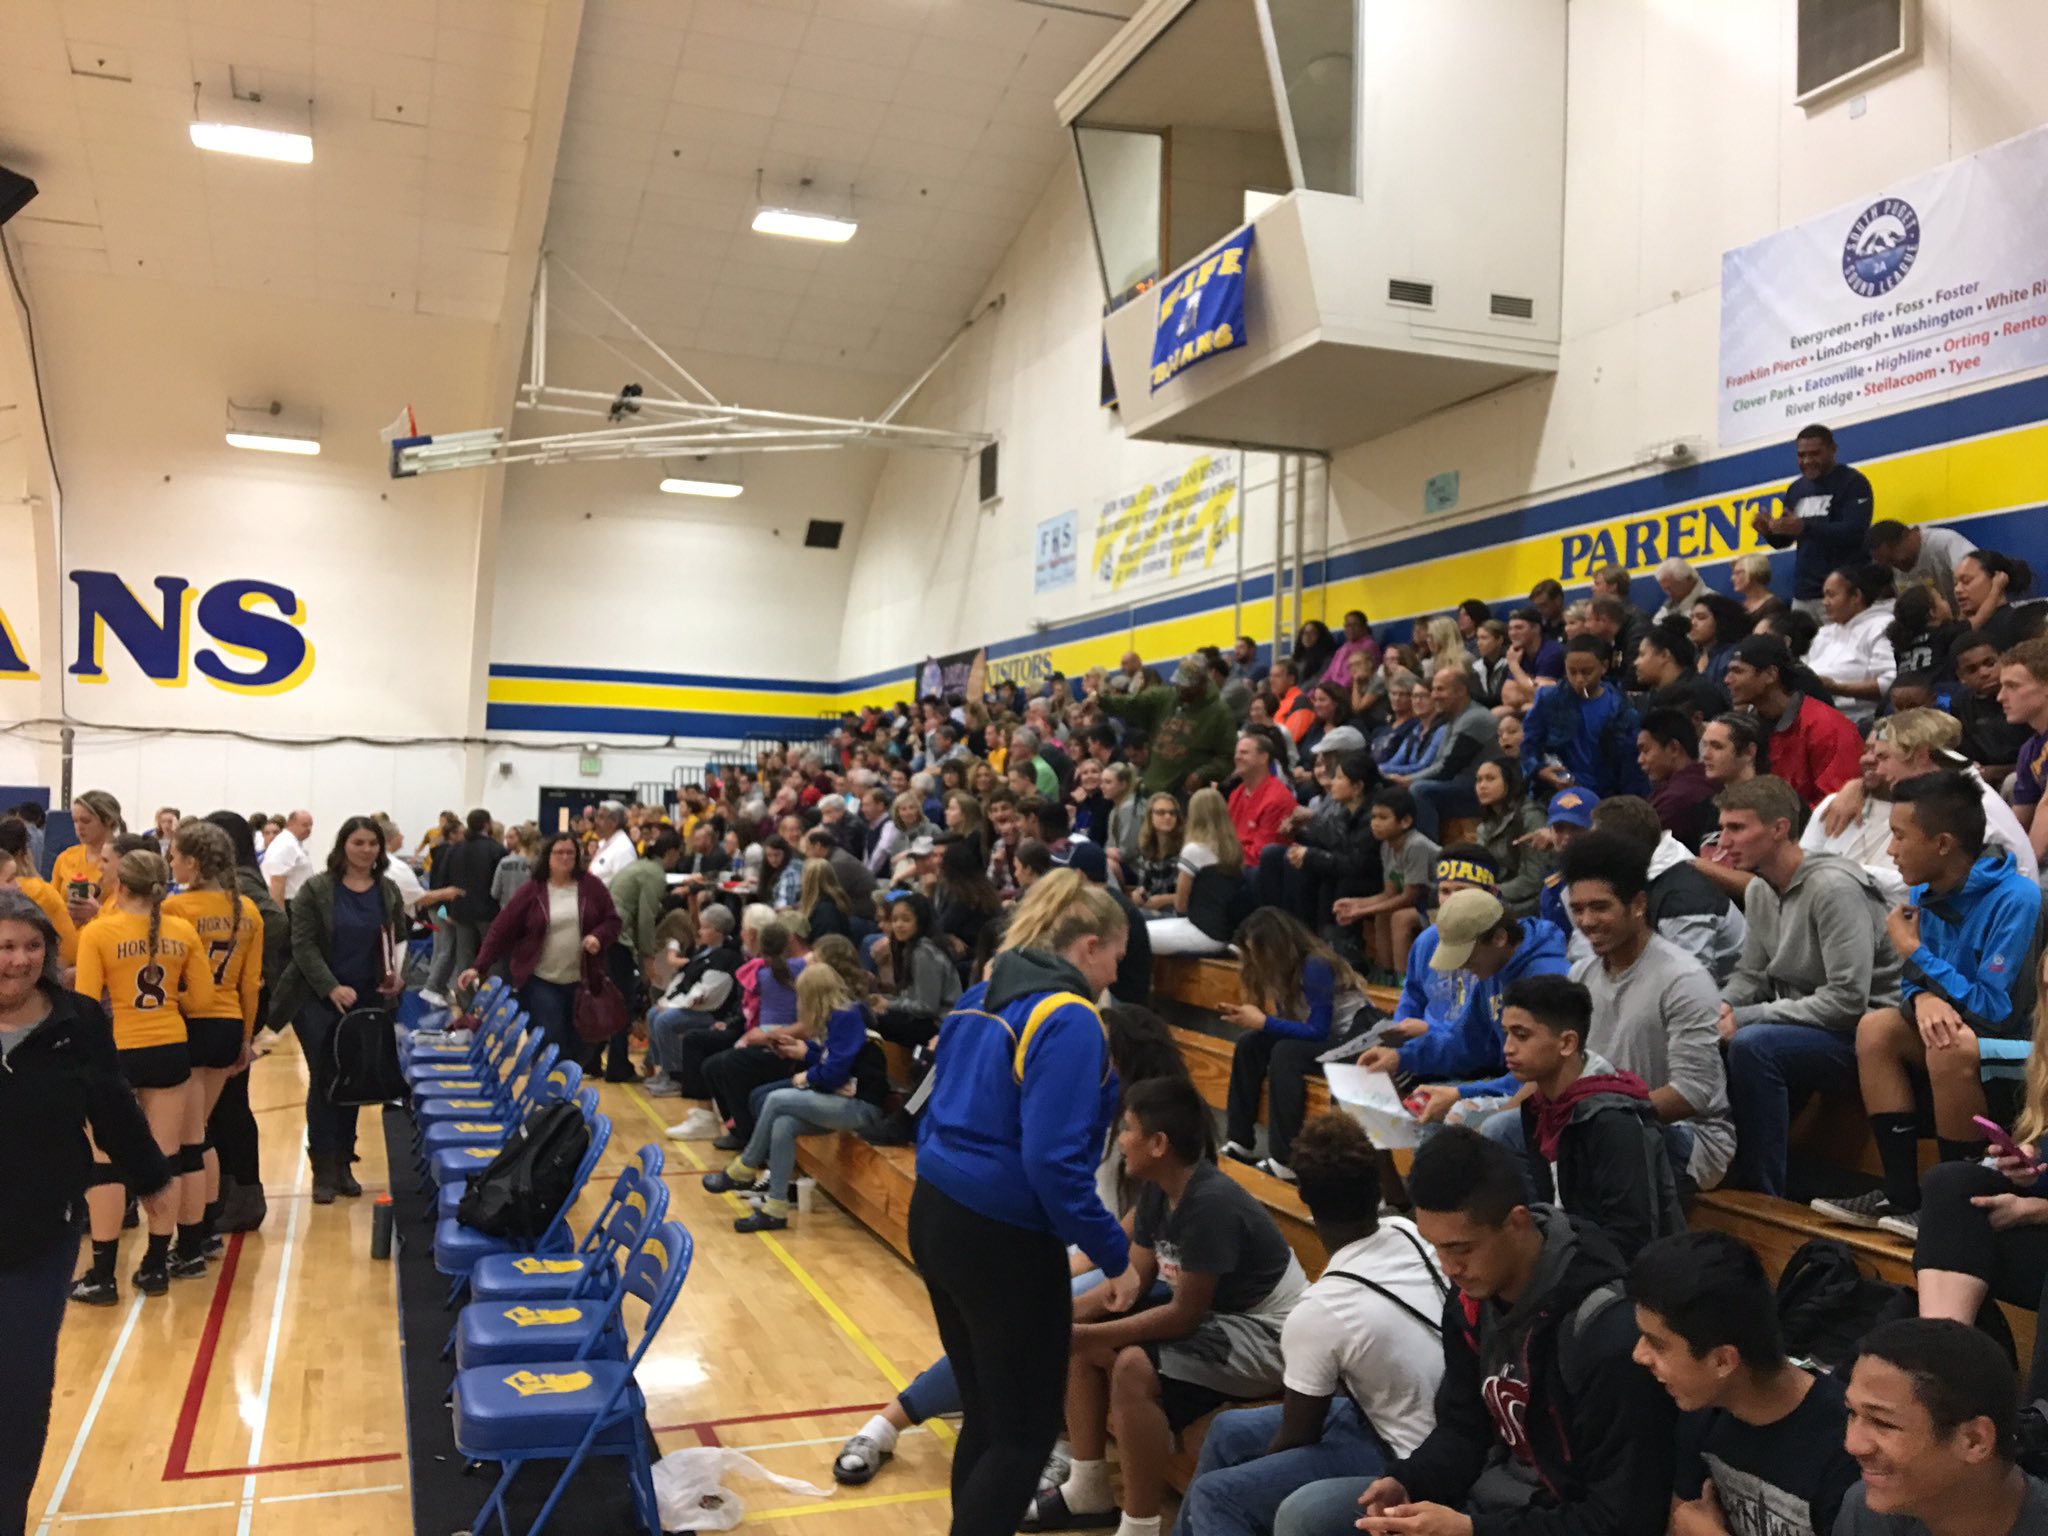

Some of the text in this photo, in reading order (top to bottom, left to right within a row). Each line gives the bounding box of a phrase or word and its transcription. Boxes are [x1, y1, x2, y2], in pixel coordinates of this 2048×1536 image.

[1884, 200, 1917, 230] PUGET
[1726, 278, 2048, 388] Franklin Pierce Lindbergh Washington White Ri
[1791, 281, 1980, 349] Evergreen Fife Foss Foster
[1732, 313, 2048, 413] Clover Park Eatonville Highline Orting Rento
[1785, 355, 1981, 417] River Ridge Steilacoom Tyee
[196, 916, 254, 932] HORNTS
[117, 938, 186, 960] HORETS
[209, 940, 237, 985] 7
[134, 964, 166, 1011] 8
